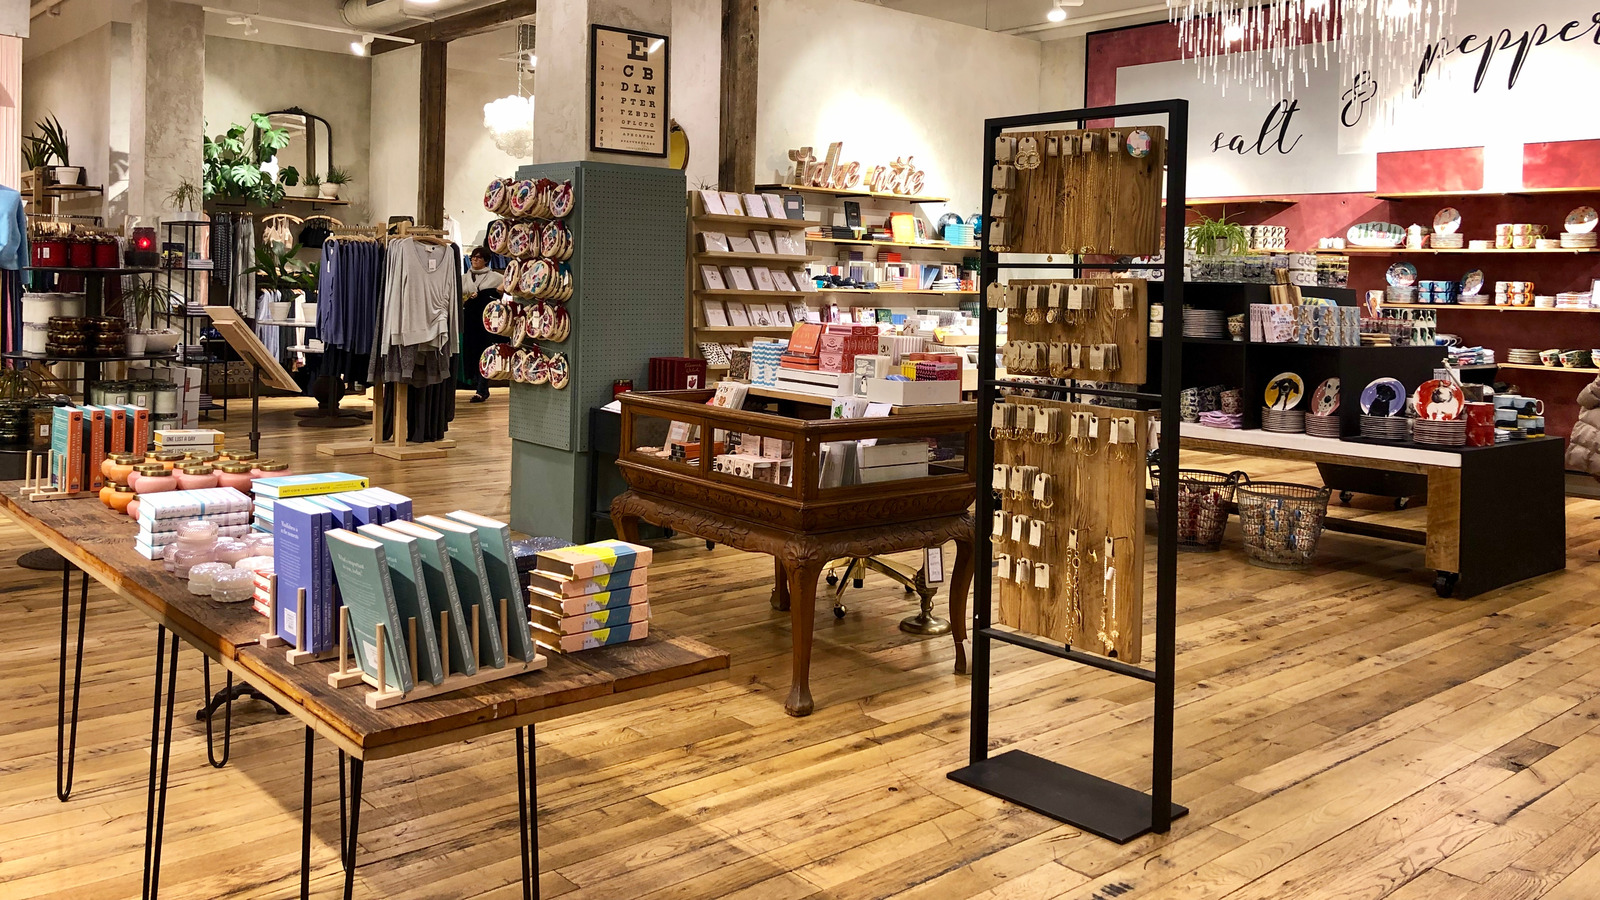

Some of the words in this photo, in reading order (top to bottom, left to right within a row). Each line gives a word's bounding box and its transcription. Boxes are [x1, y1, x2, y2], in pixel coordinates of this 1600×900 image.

[627, 34, 648, 62] E
[1210, 99, 1303, 155] salt
[1341, 71, 1378, 127] &
[789, 142, 860, 189] take
[866, 155, 925, 195] note
[383, 574, 391, 597] Minutes
[390, 614, 400, 639] Morning
[444, 562, 453, 584] Minutes
[452, 600, 463, 625] Morning
